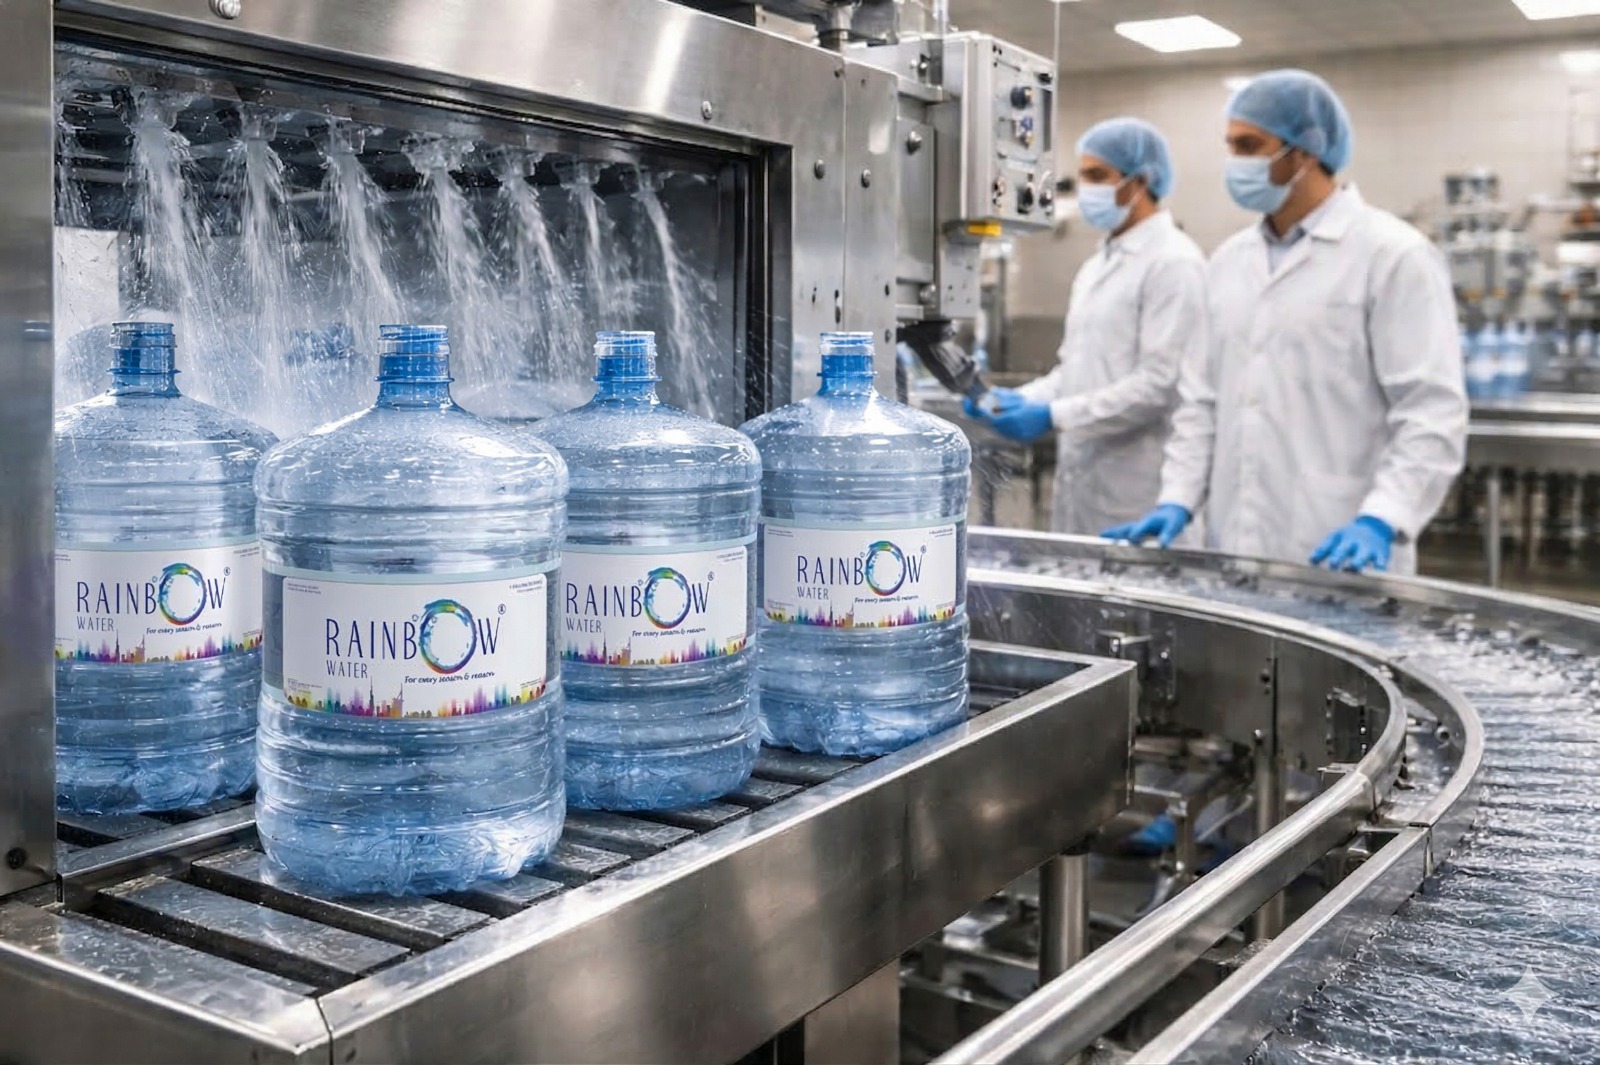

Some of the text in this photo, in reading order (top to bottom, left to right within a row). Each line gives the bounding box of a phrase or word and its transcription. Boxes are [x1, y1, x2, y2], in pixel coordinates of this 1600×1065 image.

[797, 540, 924, 596] RAINBOW
[77, 562, 227, 626] RAINBOW
[566, 567, 710, 629] RAINBOW
[797, 586, 829, 600] WATER
[77, 616, 115, 632] WATER
[566, 617, 602, 633] WATER
[326, 599, 501, 675] RAINBOW
[326, 659, 368, 679] WATER
[404, 675, 418, 684] For
[418, 676, 438, 685] every
[471, 671, 495, 679] reason
